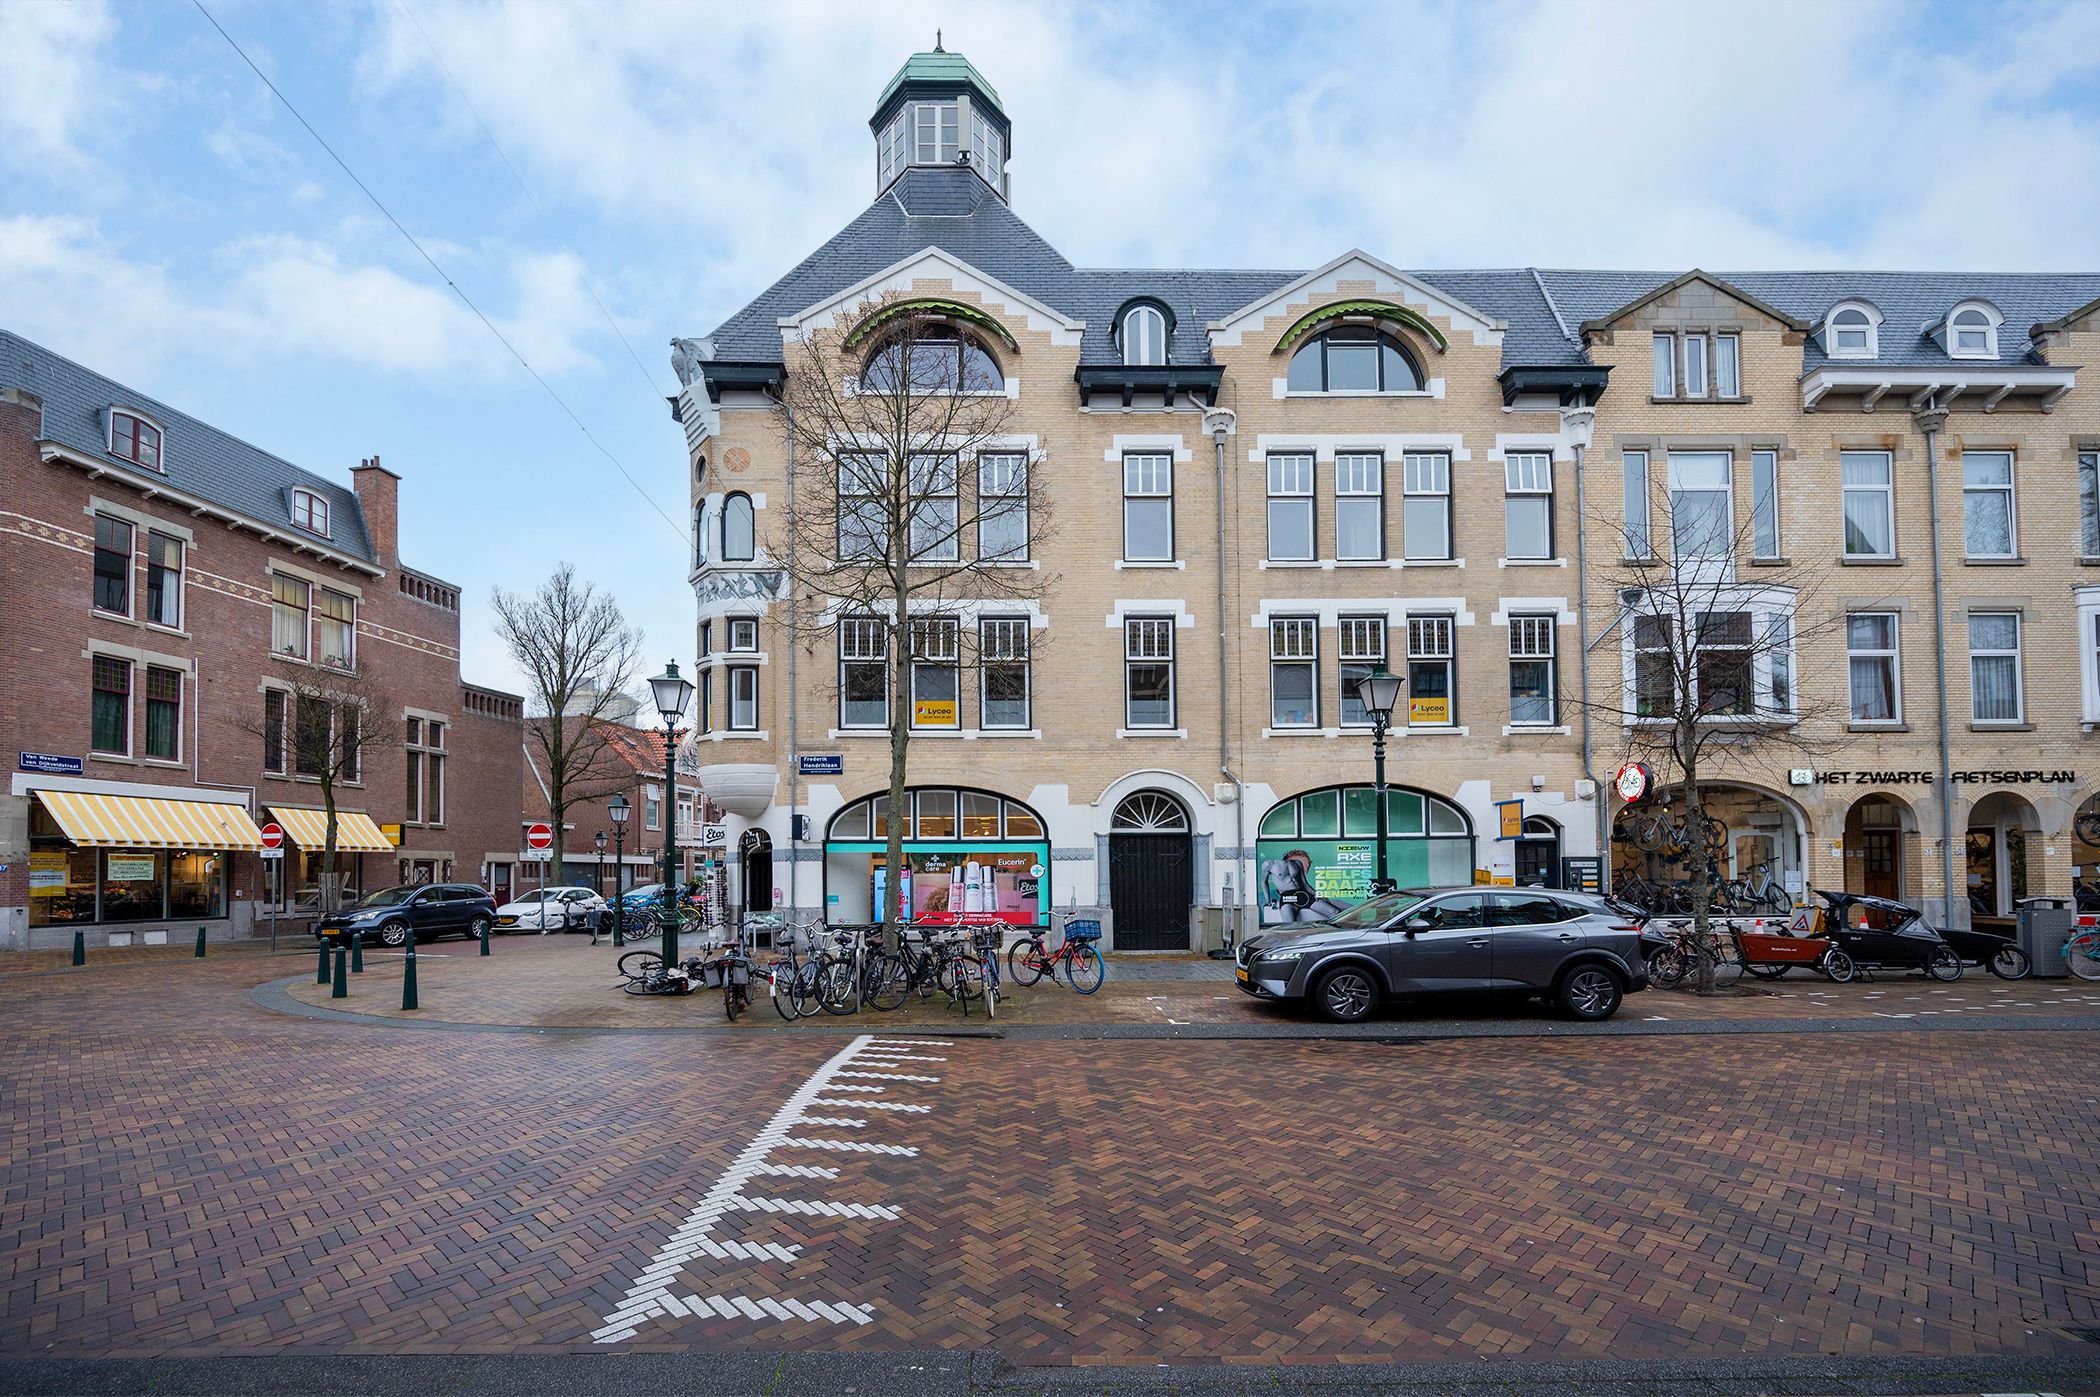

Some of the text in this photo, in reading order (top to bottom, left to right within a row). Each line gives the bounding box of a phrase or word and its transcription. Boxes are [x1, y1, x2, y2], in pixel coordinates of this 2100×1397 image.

[1815, 771, 2076, 784] HET ZWARTE FIETSENPLAN
[706, 828, 726, 840] Etos
[1337, 853, 1372, 861] AXE
[1315, 870, 1372, 880] ZELFS
[1315, 880, 1372, 890] DAAR
